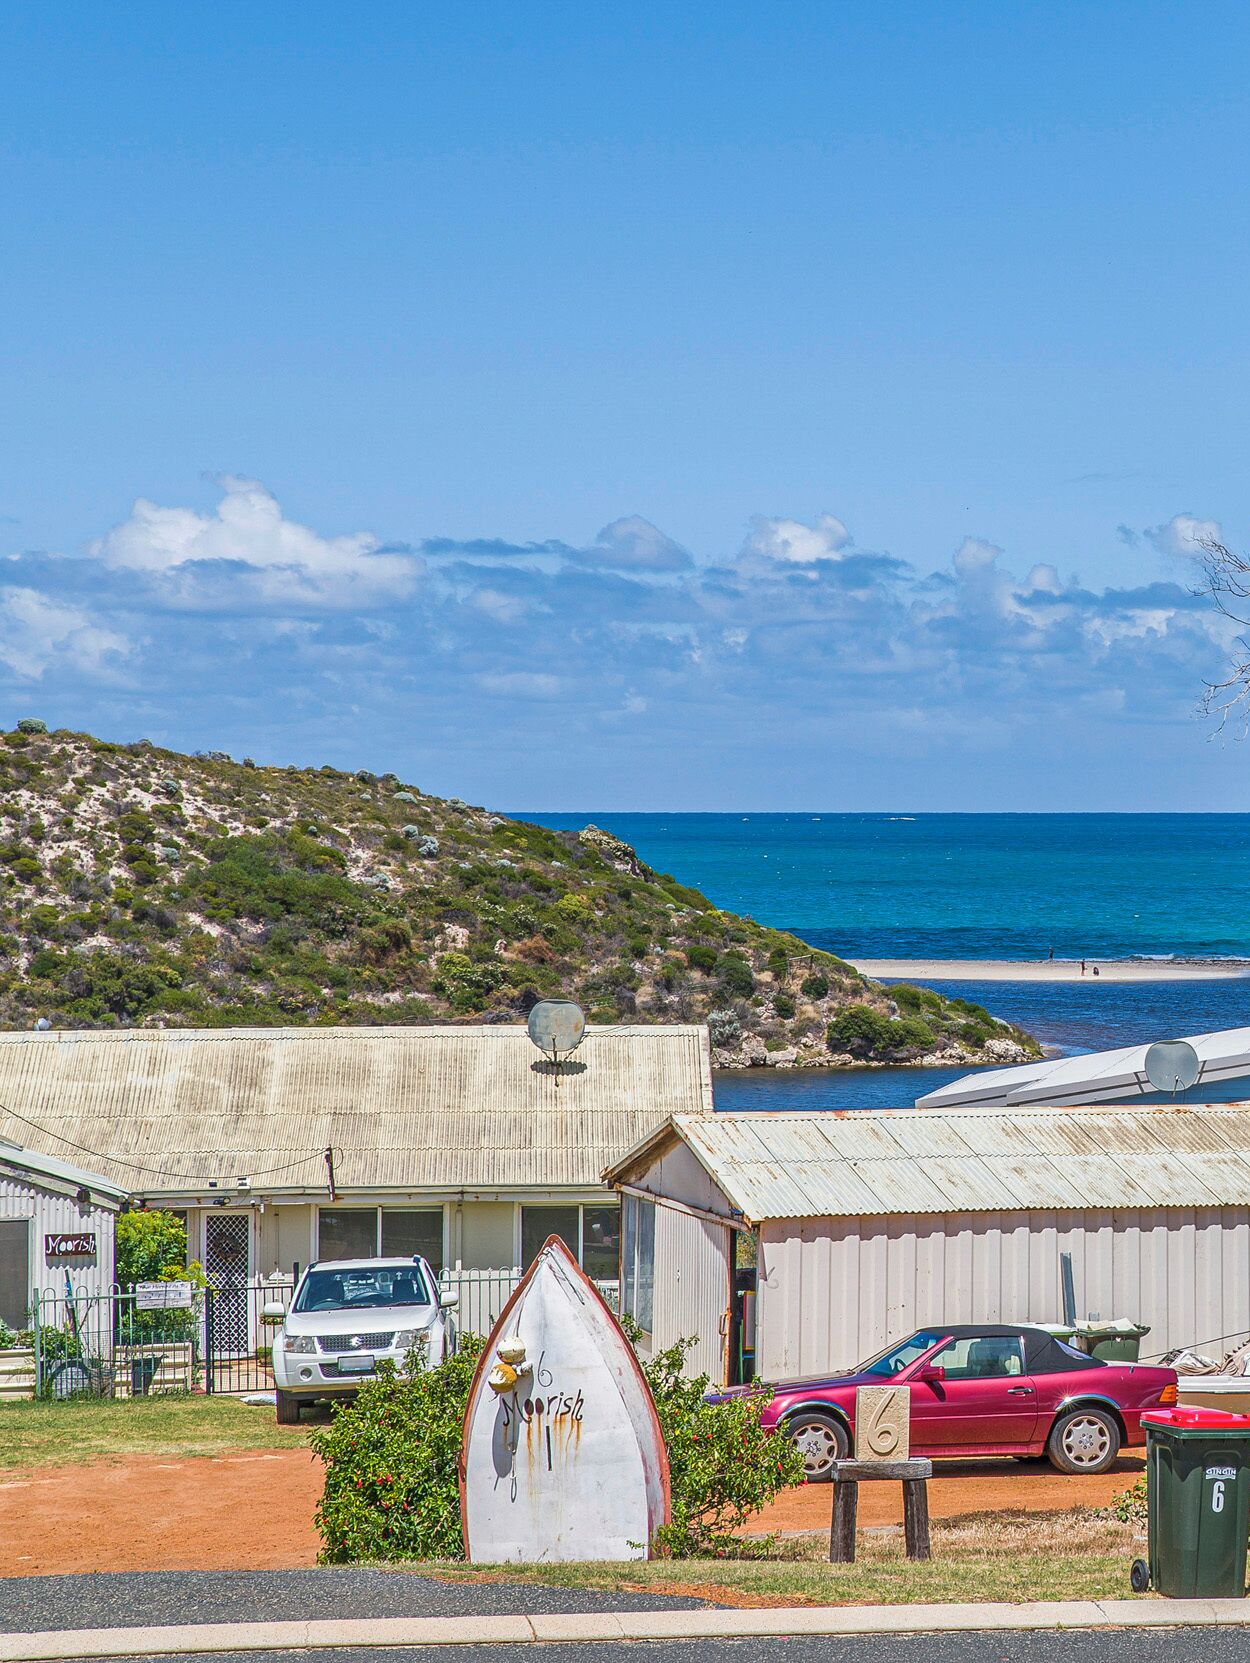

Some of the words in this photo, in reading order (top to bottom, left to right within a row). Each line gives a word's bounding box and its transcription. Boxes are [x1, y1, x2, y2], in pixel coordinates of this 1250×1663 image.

[46, 1234, 96, 1256] Moorish
[538, 1350, 553, 1388] 6
[502, 1388, 585, 1427] Moorish
[867, 1389, 900, 1457] 6
[1212, 1480, 1225, 1513] 6
